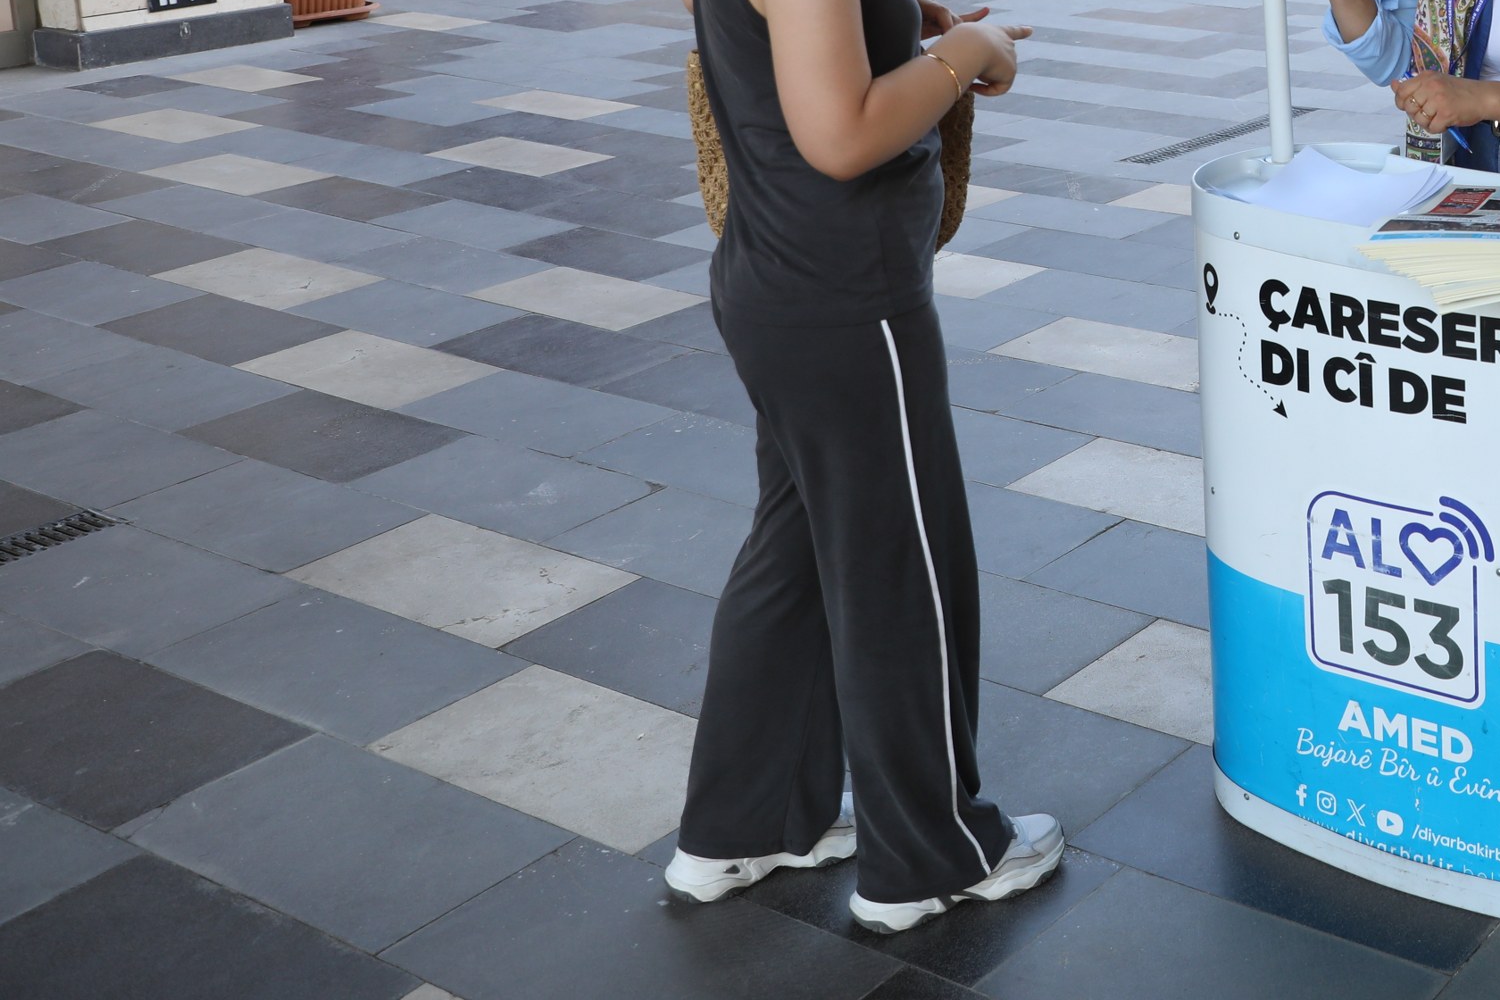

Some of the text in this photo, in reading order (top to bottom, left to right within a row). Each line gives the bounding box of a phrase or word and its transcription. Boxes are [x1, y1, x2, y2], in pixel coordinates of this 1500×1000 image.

[1260, 339, 1467, 425] DI CÎ DE
[1322, 578, 1465, 681] 153
[1296, 727, 1374, 771] Bajarê
[1426, 766, 1443, 788] û
[1338, 700, 1474, 765] AMED
